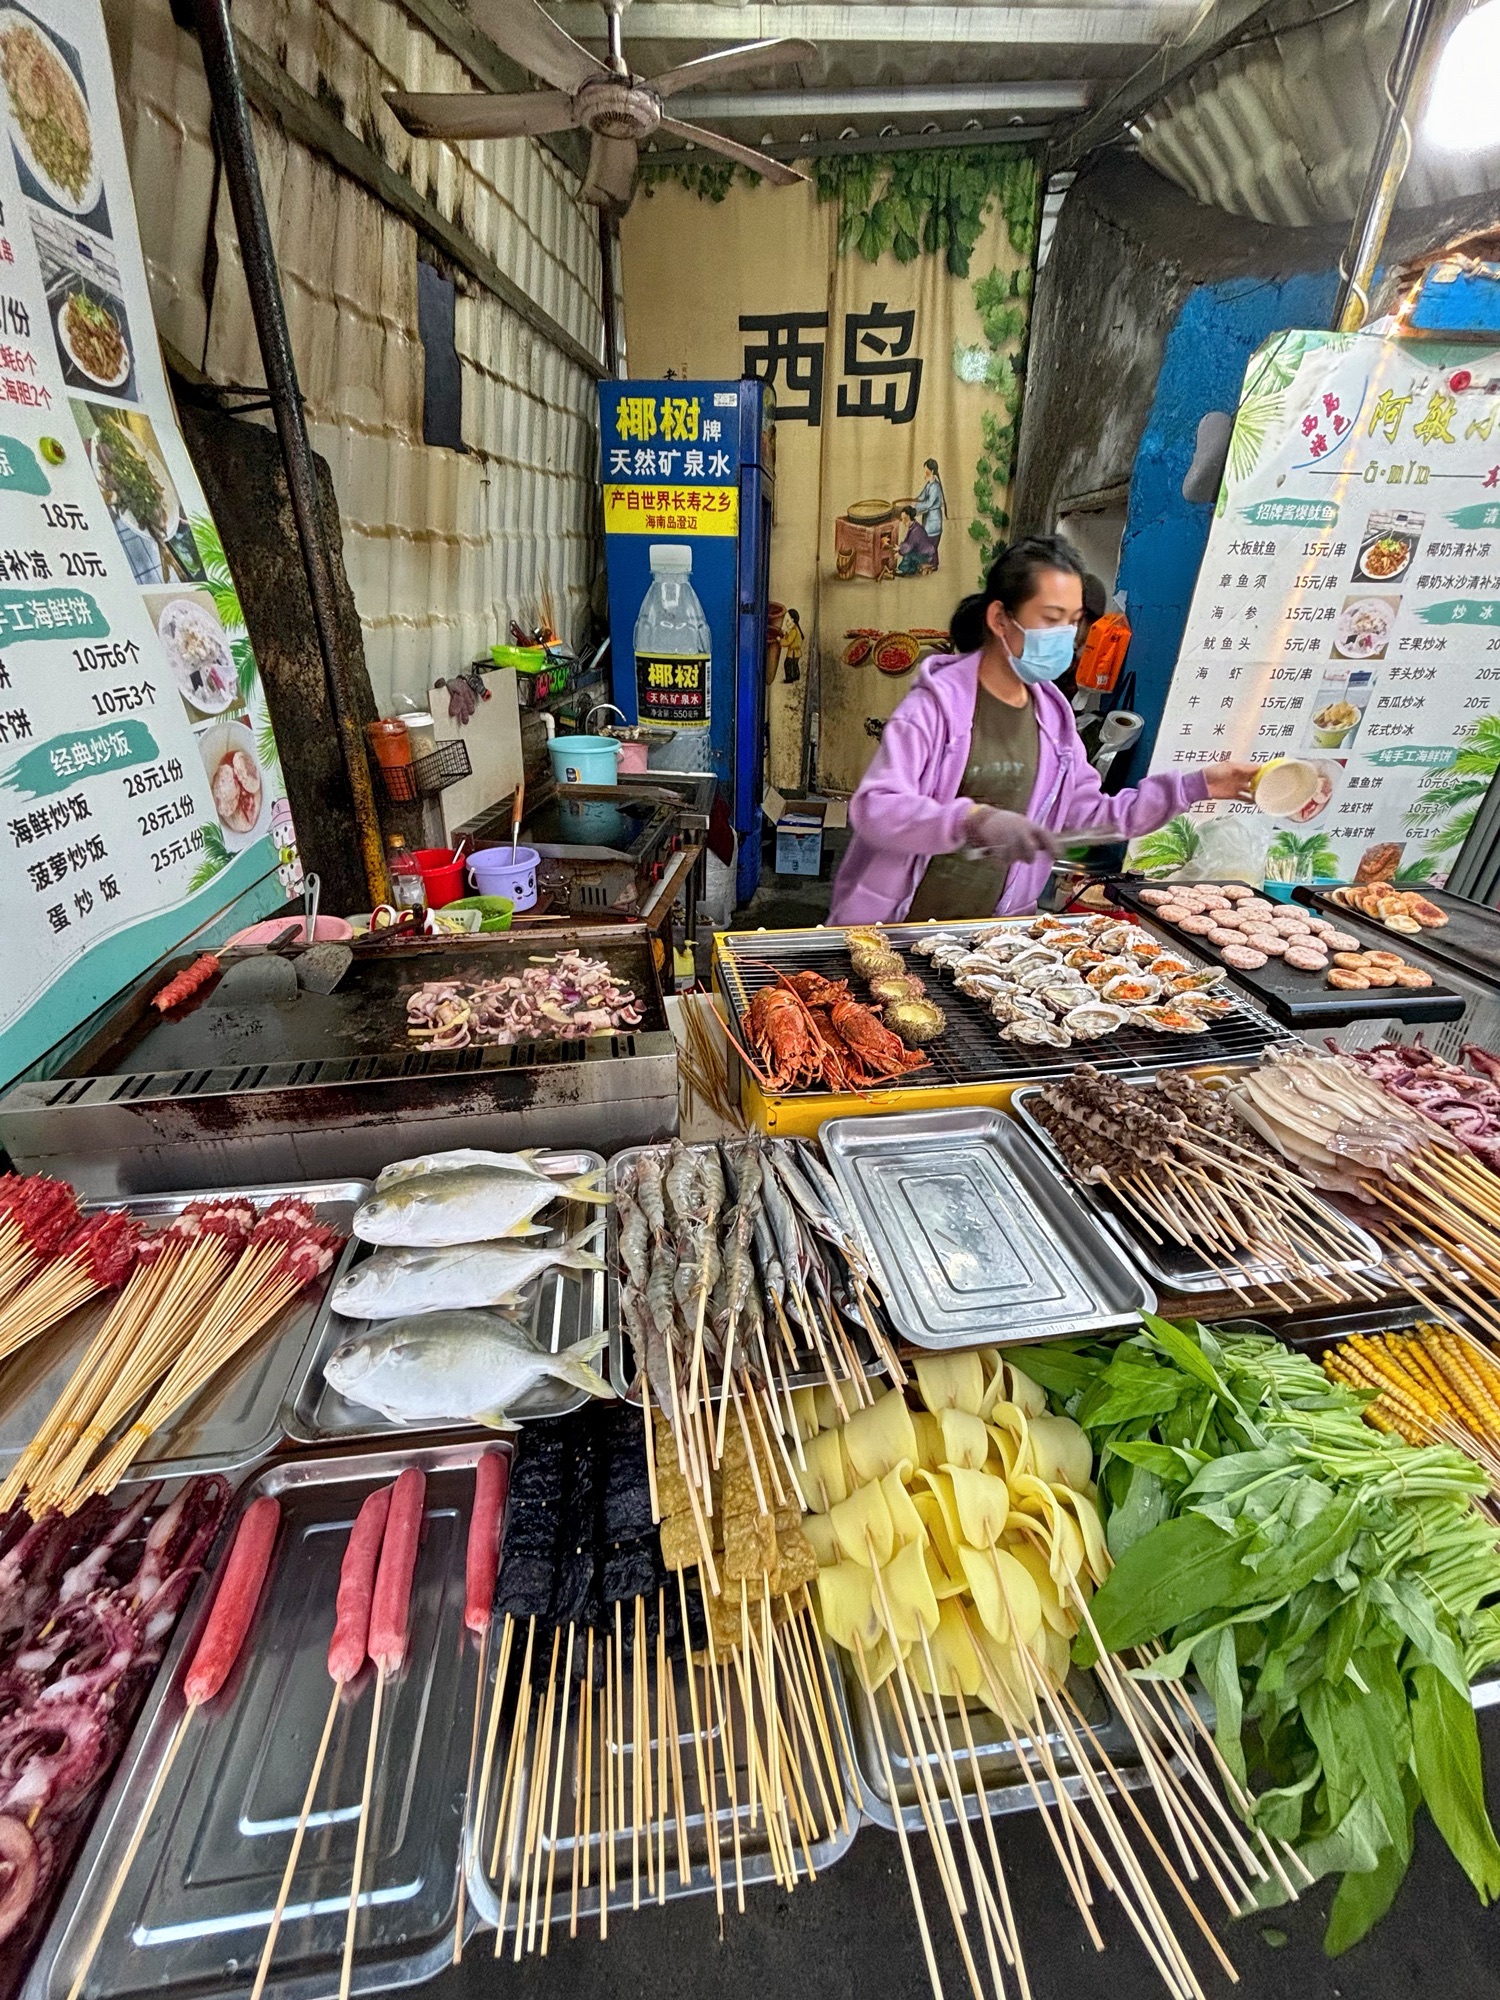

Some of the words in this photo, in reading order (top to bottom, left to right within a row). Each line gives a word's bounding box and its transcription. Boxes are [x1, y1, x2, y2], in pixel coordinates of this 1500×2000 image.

[0, 344, 38, 377] 蚝6个
[739, 303, 923, 427] 西岛
[0, 376, 52, 411] 海胆2个
[616, 397, 700, 441] 椰树
[702, 420, 722, 442] 牌
[610, 448, 731, 477] 天然矿泉水
[611, 490, 731, 512] 产自世界长寿之乡
[40, 502, 89, 531] 18元
[1256, 503, 1334, 521] 招牌酱爆鱿鱼
[645, 514, 698, 530] 海南岛澄迈
[1227, 541, 1276, 556] 大板鱿鱼
[1302, 542, 1347, 558] 15元/串
[1426, 542, 1492, 558] 椰奶清补凉
[60, 551, 108, 578] 20元
[1218, 573, 1268, 589] 章鱼须
[1294, 575, 1338, 590] 15元/串
[1286, 607, 1336, 622] 15元/2串
[1451, 604, 1494, 620] 炒冰
[1203, 636, 1251, 651] 鱿鱼头
[1284, 638, 1321, 652] 5元/串
[1398, 637, 1448, 651] 芒果炒冰
[72, 639, 140, 672] 10元6个
[648, 662, 699, 688] 椰树
[1269, 668, 1313, 681] 10元/串
[1388, 667, 1438, 681] 芋头炒冰
[91, 681, 157, 716] 10元3个
[650, 692, 699, 705] 天然矿泉水
[1188, 695, 1234, 709] 牛肉
[1260, 697, 1304, 710] 15元/捆
[1376, 696, 1426, 709] 西瓜炒冰
[1463, 697, 1491, 709] 20元
[1180, 723, 1226, 737] 玉米
[1258, 724, 1295, 737] 5元/捆
[1367, 724, 1415, 737] 花式炒冰
[1452, 725, 1479, 737] 25元
[50, 729, 133, 777] 经典炒饭
[1172, 751, 1232, 763] 王中王火腿
[1378, 749, 1453, 763] 纯手工海鲜饼
[1347, 777, 1383, 789] 墨鱼饼
[1417, 778, 1460, 789] 10元6个
[7, 793, 92, 848] 海鲜炒饭
[123, 758, 184, 798] 28元1份
[1187, 802, 1217, 814] 土豆
[1228, 803, 1265, 815] 20元/
[1338, 802, 1373, 814] 龙虾饼
[1407, 803, 1449, 814] 10元3个
[1330, 827, 1376, 838] 大海虾饼
[1405, 828, 1440, 839] 6元1个
[27, 834, 108, 892] 菠萝炒饭
[137, 794, 196, 836] 28元1份
[47, 873, 121, 934] 蛋炒饭
[151, 828, 205, 872] 25元1份
